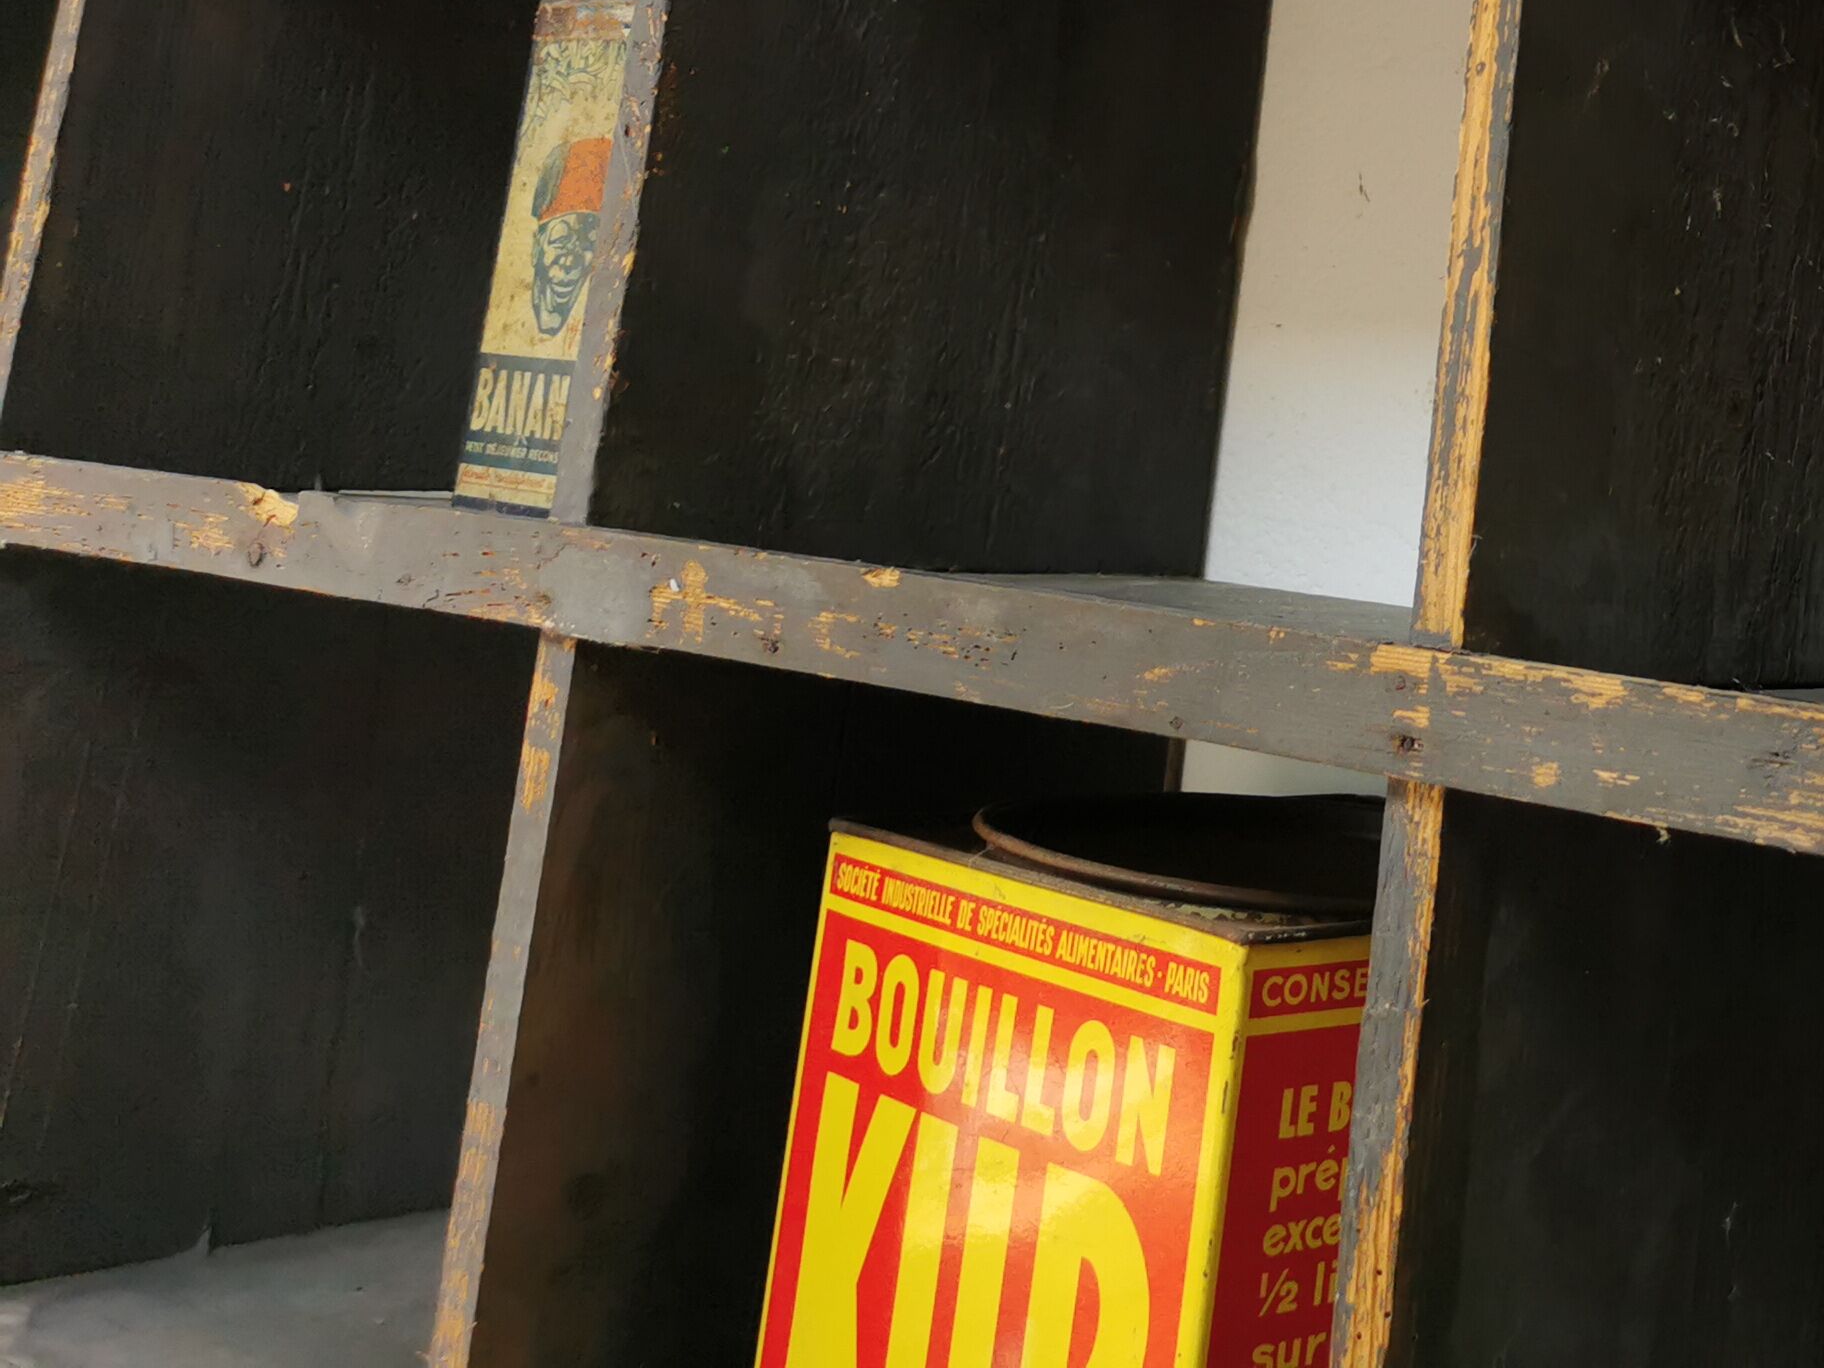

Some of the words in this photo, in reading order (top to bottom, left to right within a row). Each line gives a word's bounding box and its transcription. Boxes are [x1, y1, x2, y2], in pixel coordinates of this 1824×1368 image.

[836, 862, 882, 901] SOCIÉTÉ
[881, 876, 957, 925] INDUSTRIELLE
[956, 899, 976, 931] DE
[977, 905, 1055, 956] SPÉCIALITÉS
[1055, 930, 1156, 987] ALIMENTAIRES
[1164, 961, 1210, 1003] PARIS
[831, 938, 1177, 1177] BOUILLON
[1278, 1084, 1319, 1139] LE
